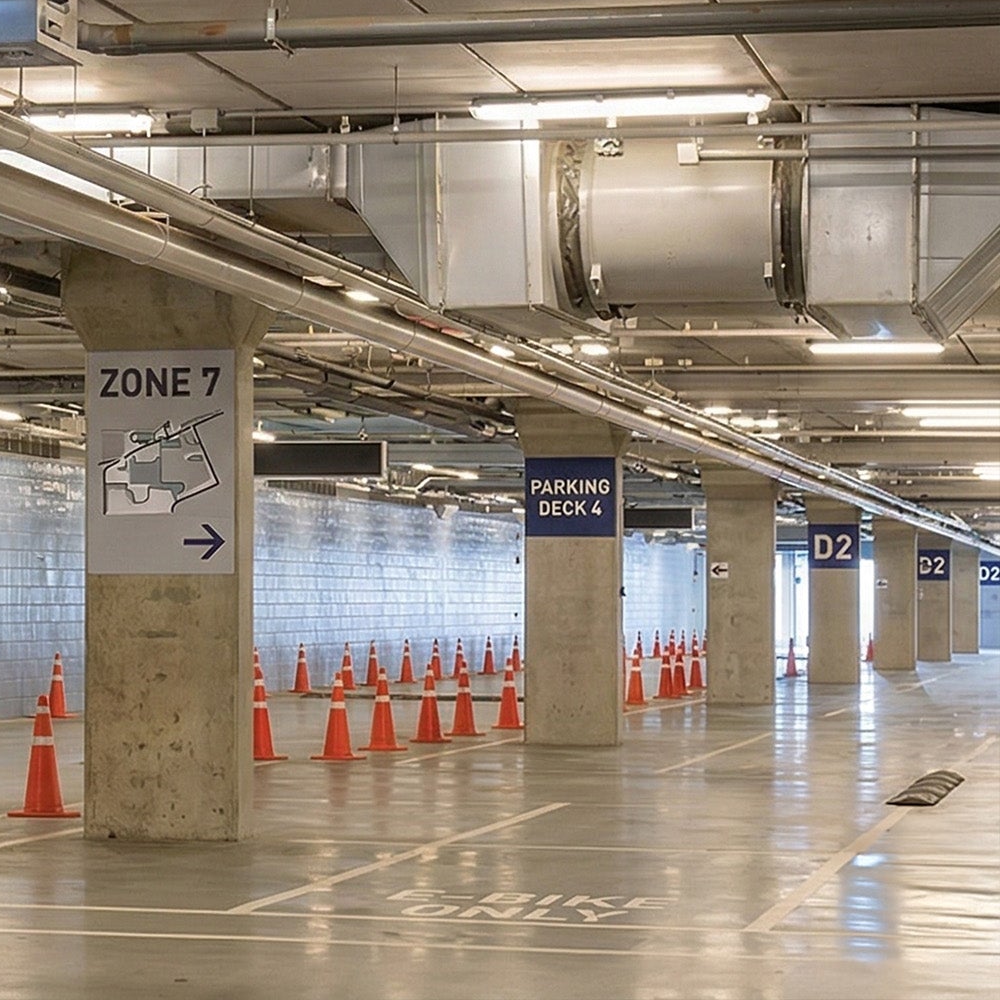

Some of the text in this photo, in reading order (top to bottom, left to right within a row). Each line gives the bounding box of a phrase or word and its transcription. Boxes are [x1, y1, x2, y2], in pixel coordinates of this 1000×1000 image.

[100, 367, 221, 398] ZONE 7
[531, 479, 610, 495] PARKING
[539, 500, 602, 516] DECK 4
[814, 534, 852, 560] D2
[919, 556, 945, 575] D2
[979, 566, 1000, 582] D2
[386, 889, 679, 909] E-BIKE
[400, 904, 629, 922] ONLY
